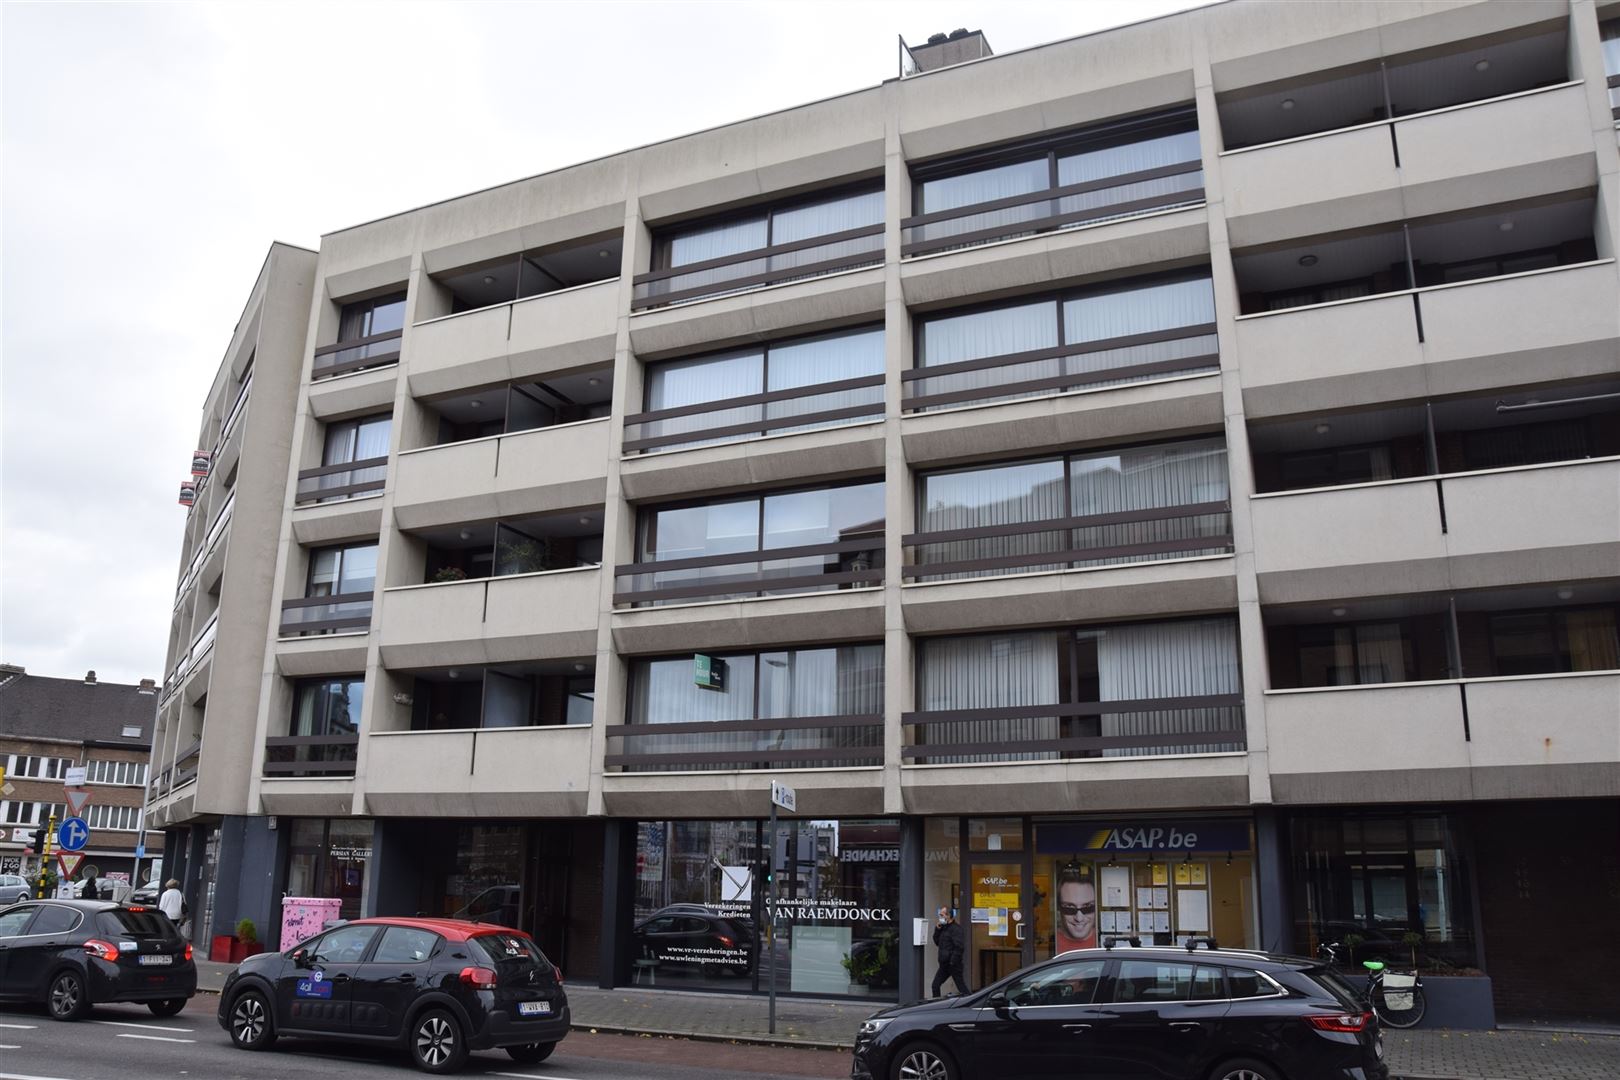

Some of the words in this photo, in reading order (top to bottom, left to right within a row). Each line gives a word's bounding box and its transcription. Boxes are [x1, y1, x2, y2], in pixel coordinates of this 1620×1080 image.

[1103, 827, 1197, 849] ASAP.be
[704, 902, 751, 911] Verzekeringen
[765, 897, 818, 907] Oafhankelijke
[819, 898, 857, 906] makelaars
[717, 910, 751, 918] Kredieten
[797, 907, 891, 920] RAEMDONCK
[667, 947, 748, 957] www.vr-verzekeringen.be
[659, 955, 748, 965] www.uwleningmetadvies.be
